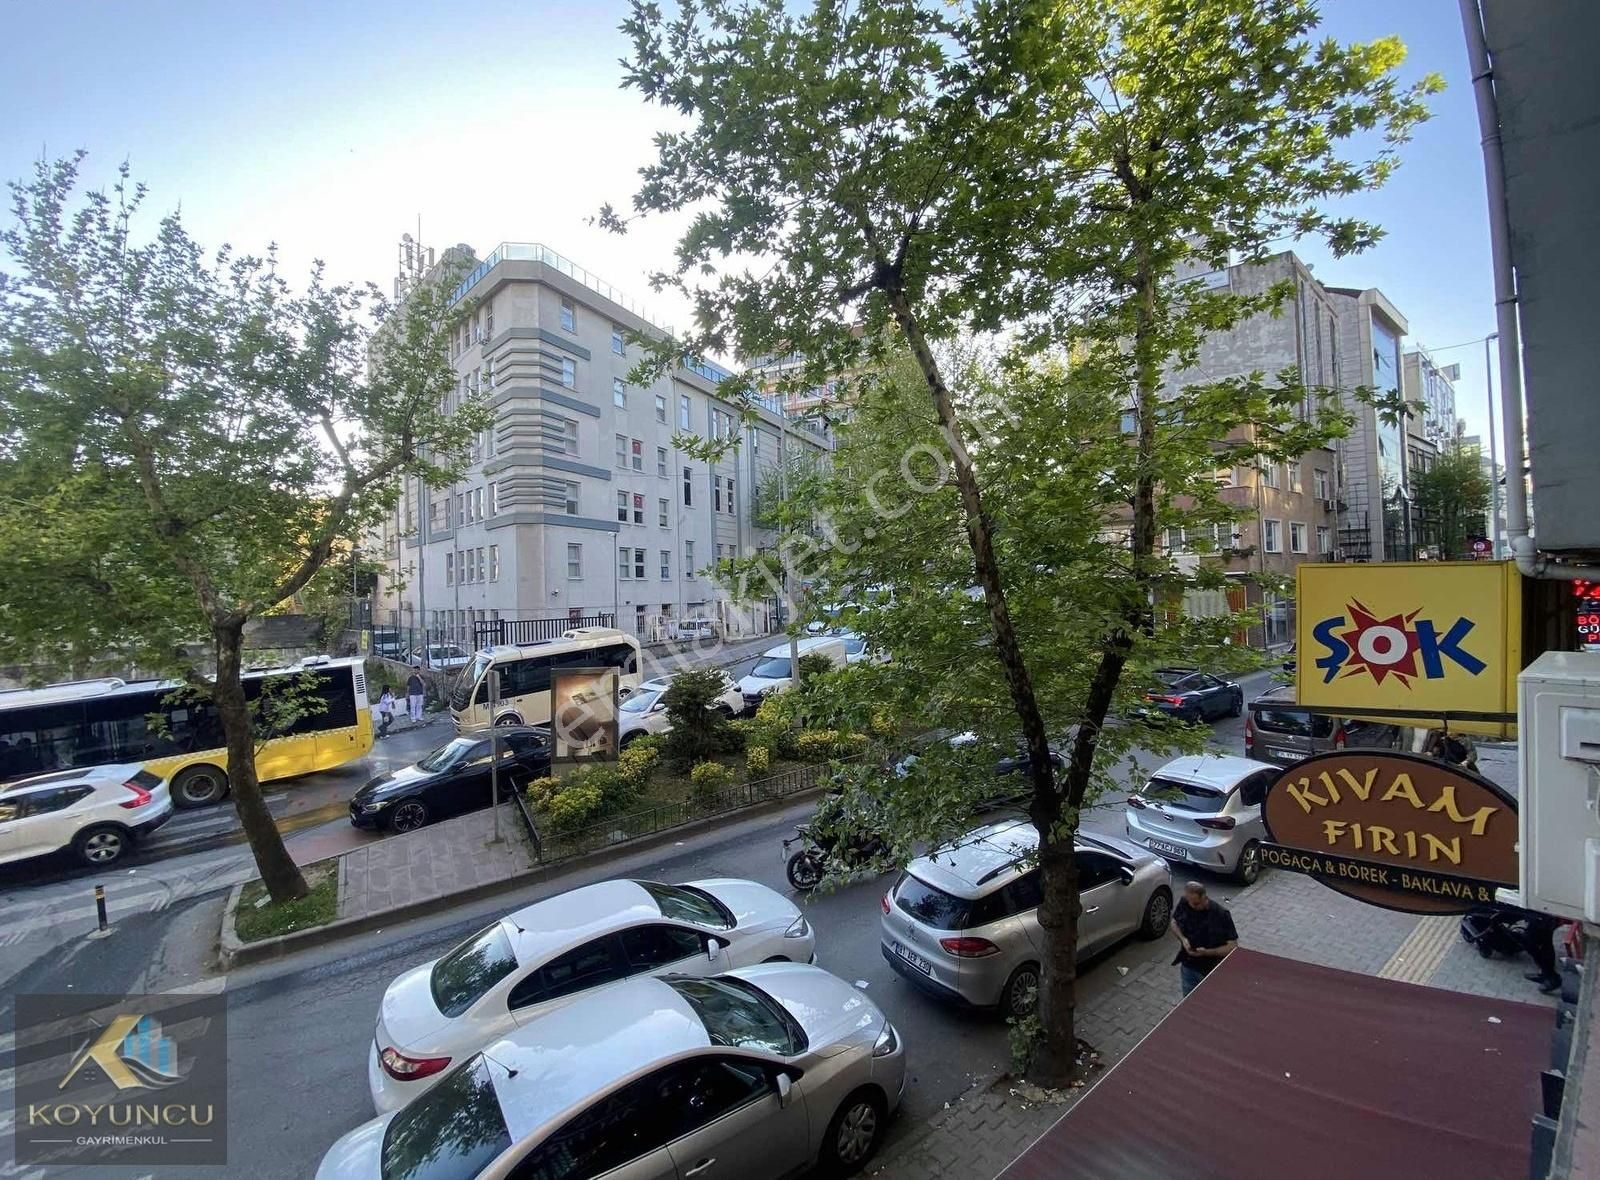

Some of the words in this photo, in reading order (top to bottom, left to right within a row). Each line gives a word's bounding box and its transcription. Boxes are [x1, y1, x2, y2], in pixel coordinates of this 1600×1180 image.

[1312, 616, 1487, 684] ŞOK
[1286, 768, 1499, 835] KIVAM
[1322, 819, 1461, 865] FIRIN
[1261, 848, 1322, 874] POĞAÇA
[1325, 857, 1336, 875] &
[1339, 861, 1389, 885] BÖREK
[1402, 873, 1474, 899] BAKLAVA
[1478, 886, 1491, 902] &
